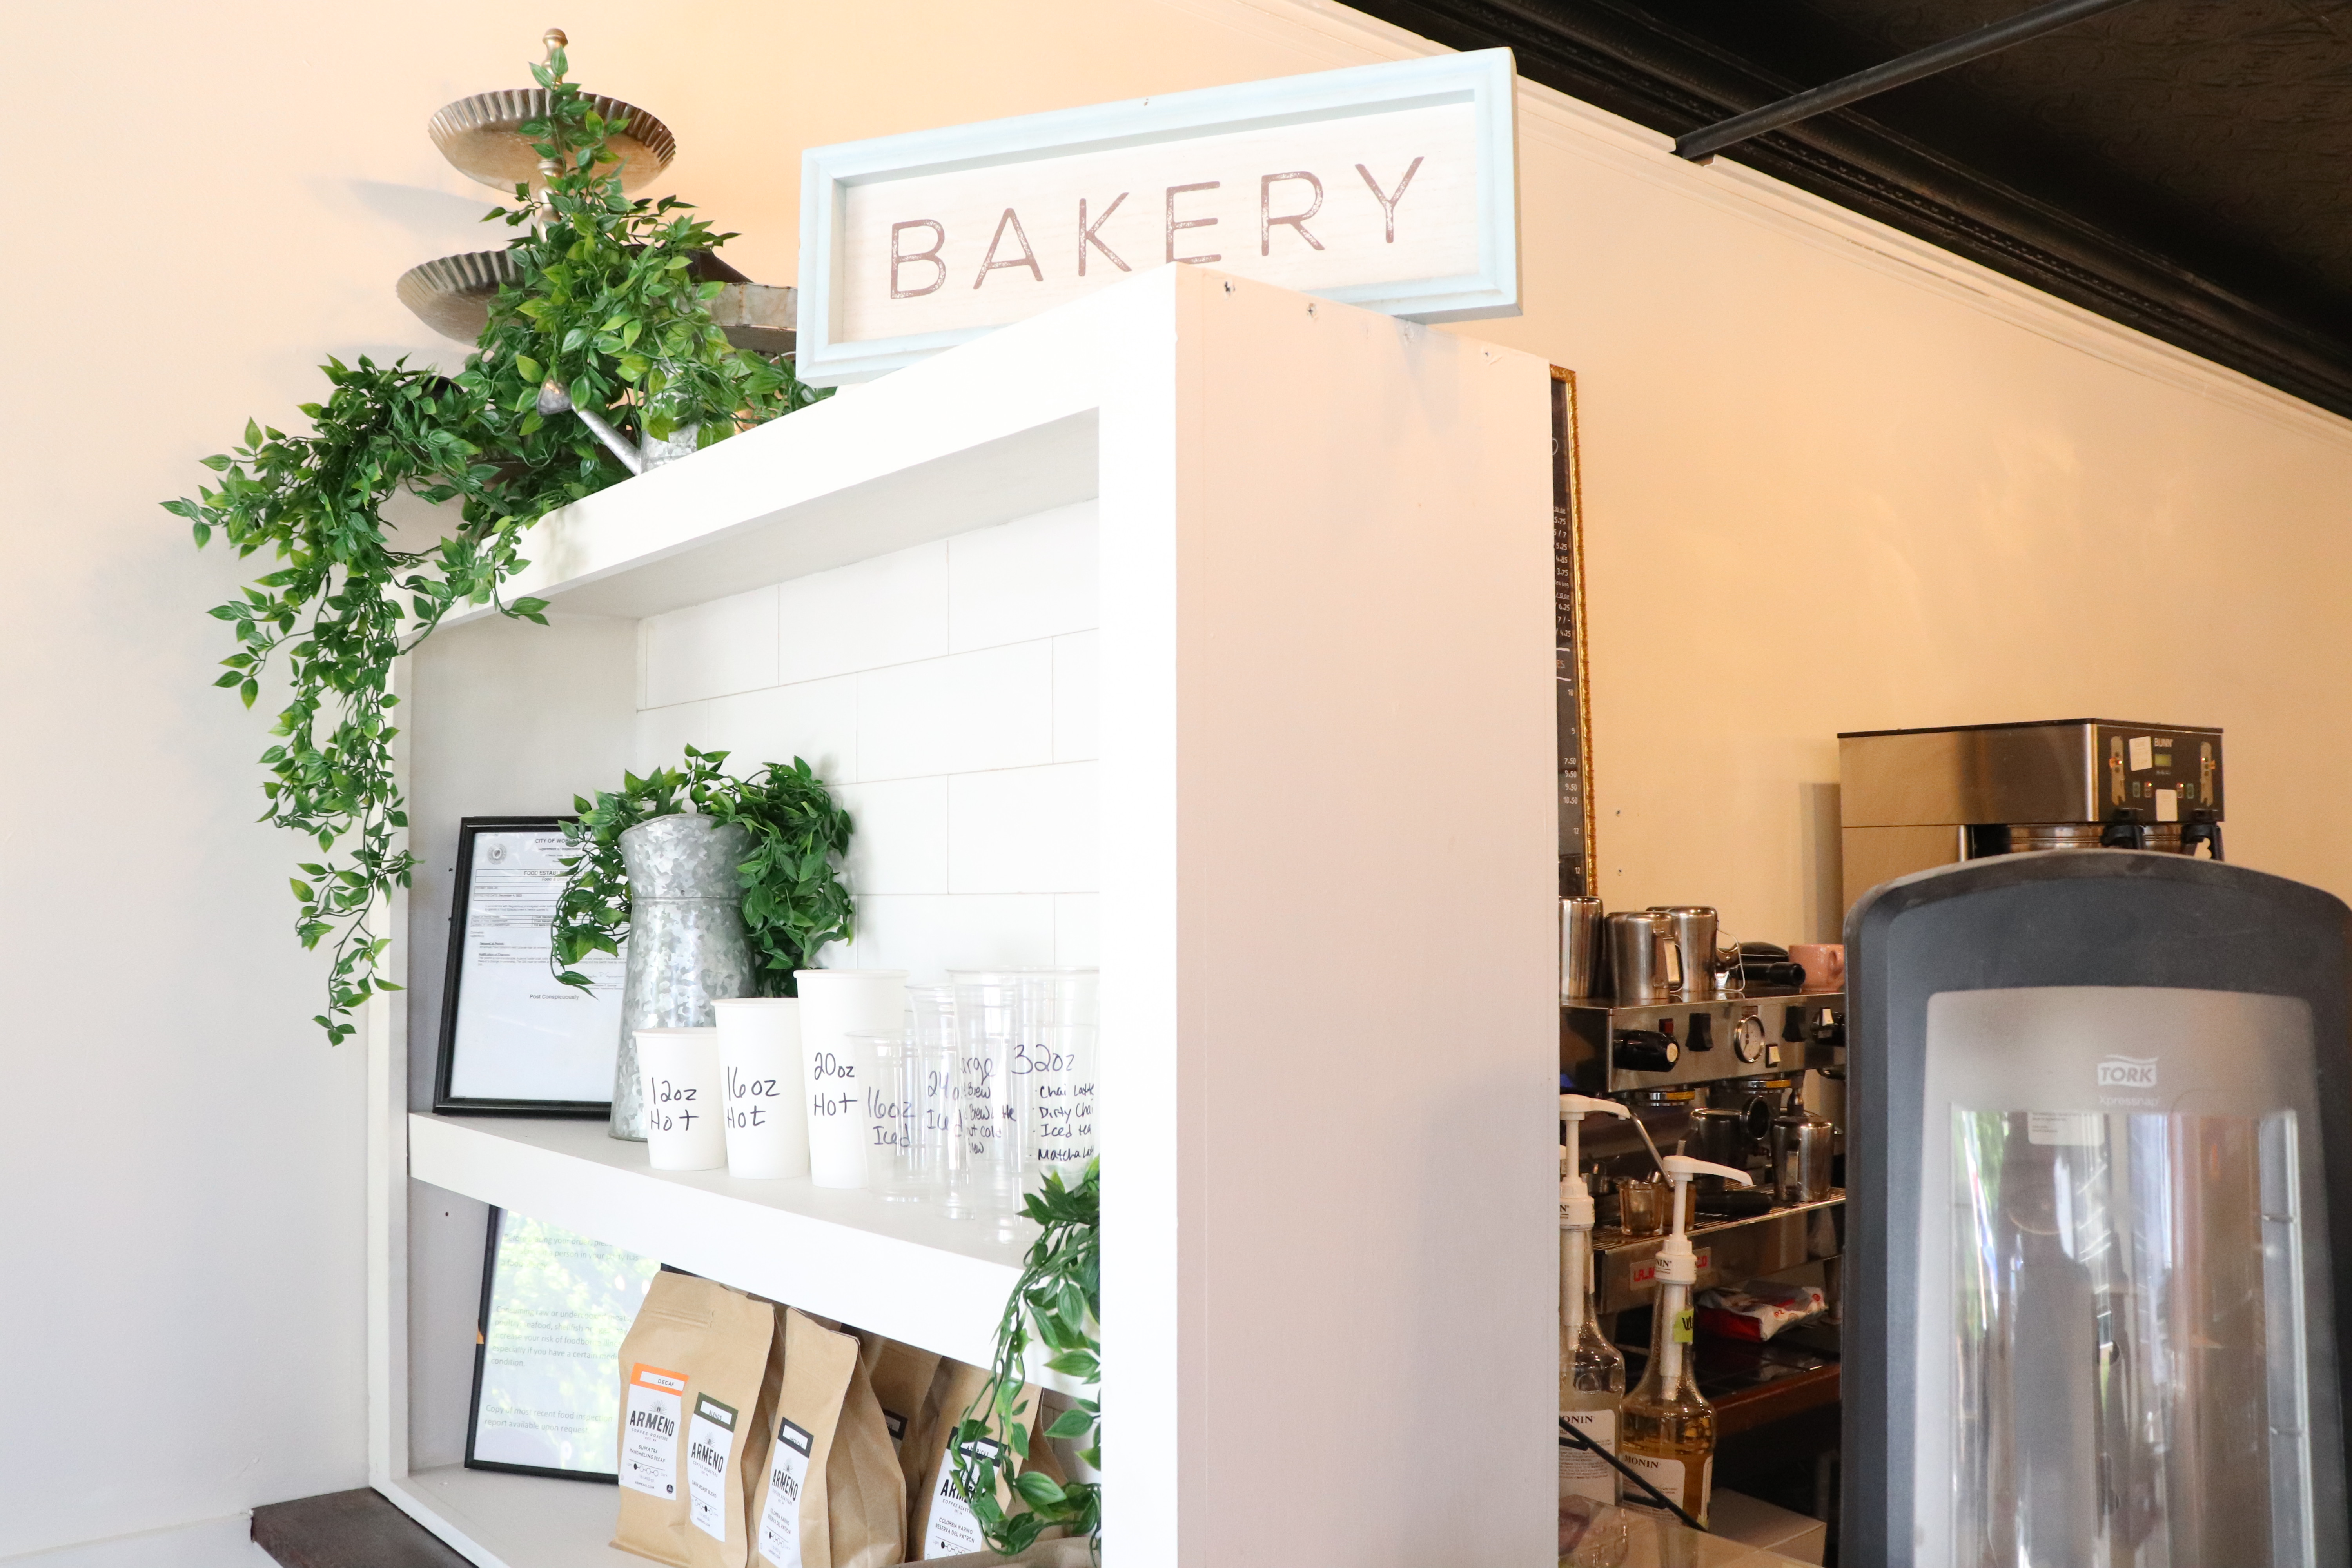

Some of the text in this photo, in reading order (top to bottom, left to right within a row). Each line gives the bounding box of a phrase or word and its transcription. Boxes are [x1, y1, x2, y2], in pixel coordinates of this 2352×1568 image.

[891, 156, 1424, 300] BAKERY
[1557, 568, 1568, 576] 3.75
[1565, 783, 1577, 791] 9.50
[2100, 1066, 2152, 1082] TORK
[814, 1092, 858, 1116] Hot
[651, 1108, 699, 1131] Hot
[727, 1105, 766, 1128] Hot
[1039, 1106, 1071, 1124] Dirty
[1041, 1124, 1072, 1138] Iced
[555, 1250, 579, 1259] person
[496, 1306, 534, 1317] Consuming
[492, 1346, 526, 1355] especially
[486, 1405, 504, 1414] Copy
[558, 1411, 574, 1419] food
[576, 1413, 613, 1423] inspection
[709, 1410, 722, 1421] BLENDS
[485, 1419, 507, 1427] report
[509, 1421, 539, 1430] available
[630, 1410, 675, 1437] ARMENO
[650, 1433, 668, 1441] ROASTERS
[629, 1448, 653, 1459] MANDHELING
[638, 1445, 658, 1454] SUMATRA
[967, 1445, 989, 1457] AMRICAS
[691, 1442, 724, 1473] ARMENO
[1624, 1454, 1659, 1468] MONIN
[693, 1460, 718, 1477] COFFEE ROASTERS
[772, 1469, 798, 1501] ARMENO
[942, 1499, 958, 1508] COFFEE
[935, 1523, 951, 1534] RESERVA
[959, 1533, 975, 1543] PATRON
[939, 1517, 973, 1535] COLOMBIA NARINO
